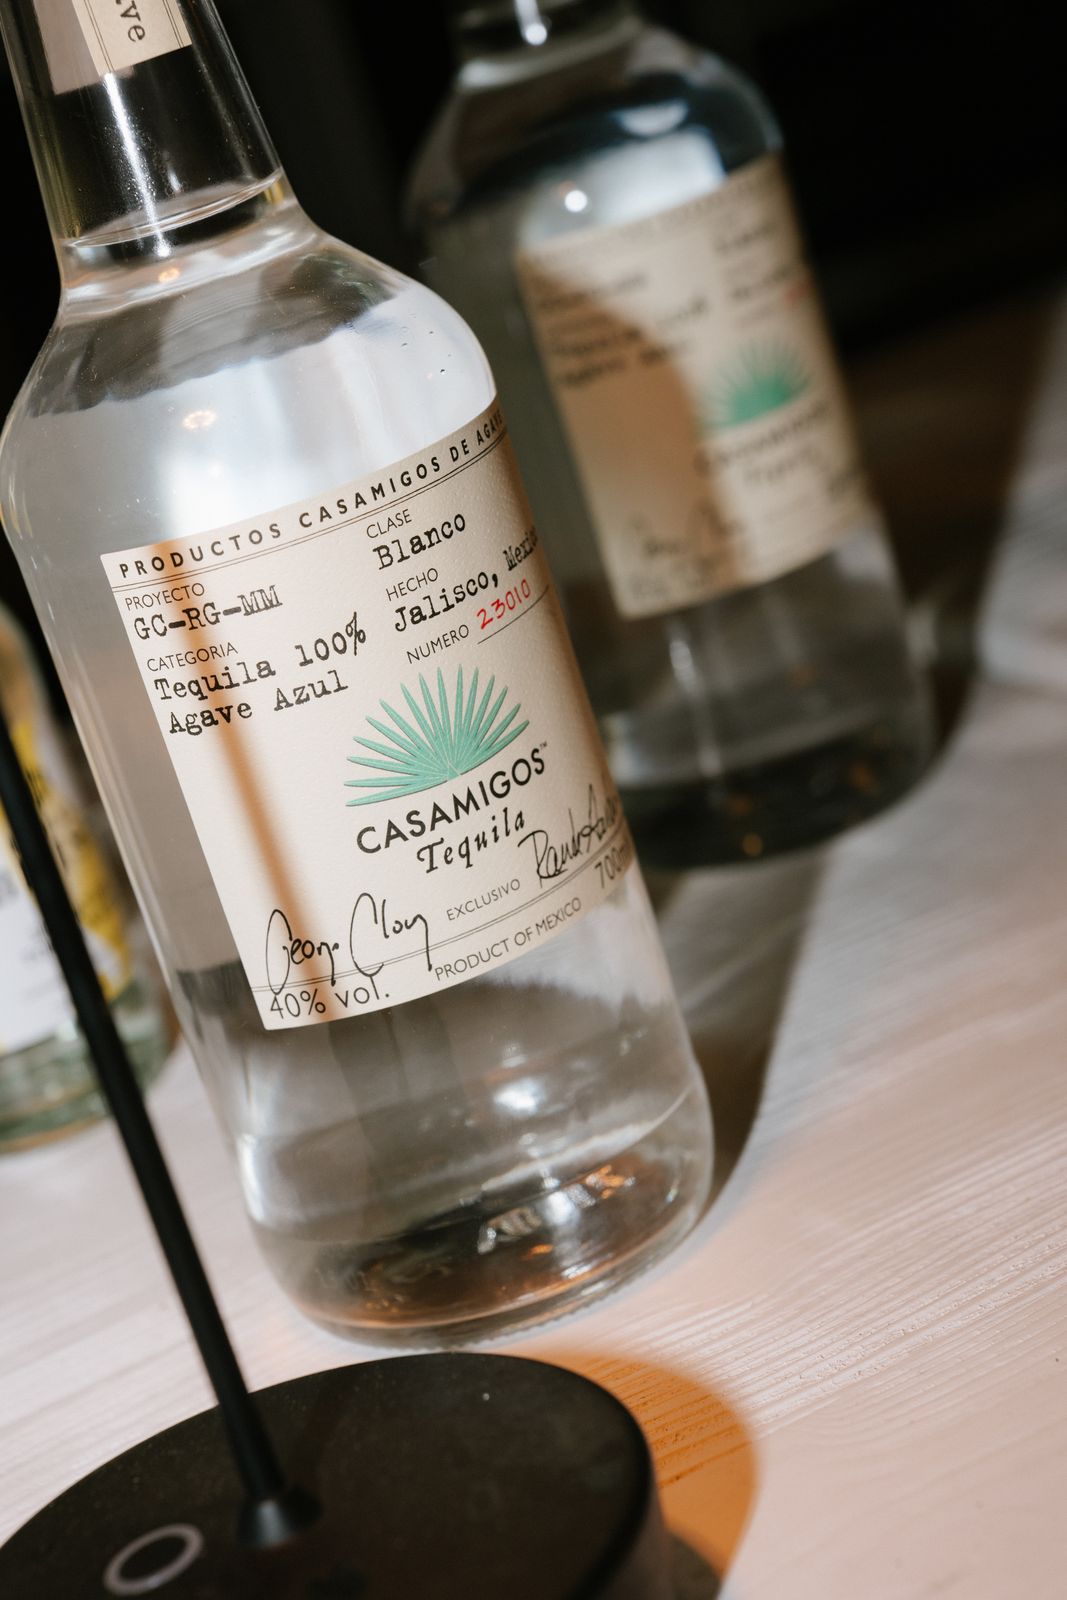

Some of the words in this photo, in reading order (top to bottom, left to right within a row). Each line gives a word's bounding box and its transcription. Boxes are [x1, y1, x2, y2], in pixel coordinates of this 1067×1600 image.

[119, 523, 281, 578] PRODUCTOS
[299, 456, 440, 528] CASAMIGOS
[449, 438, 470, 462] DE
[366, 508, 412, 539] CLASE
[372, 513, 466, 570] Blanco
[125, 582, 205, 611] PROYECTO
[133, 584, 283, 640] GC-RG-MM
[386, 567, 439, 601] HECHO
[394, 571, 499, 632] Jalisco,
[406, 624, 469, 664] NUMERO
[476, 578, 531, 630] 23010
[146, 642, 238, 672] CATEGORIA
[154, 660, 276, 701] Tequila
[294, 611, 367, 667] 100%
[169, 702, 253, 736] Agave
[273, 669, 349, 711] Azul
[416, 806, 525, 874] Tequila
[446, 878, 521, 921] EXCLUSIVO
[434, 938, 509, 981] PRODUCT
[513, 927, 535, 947] OF
[535, 897, 582, 937] MEXICO
[270, 988, 326, 1019] 40%
